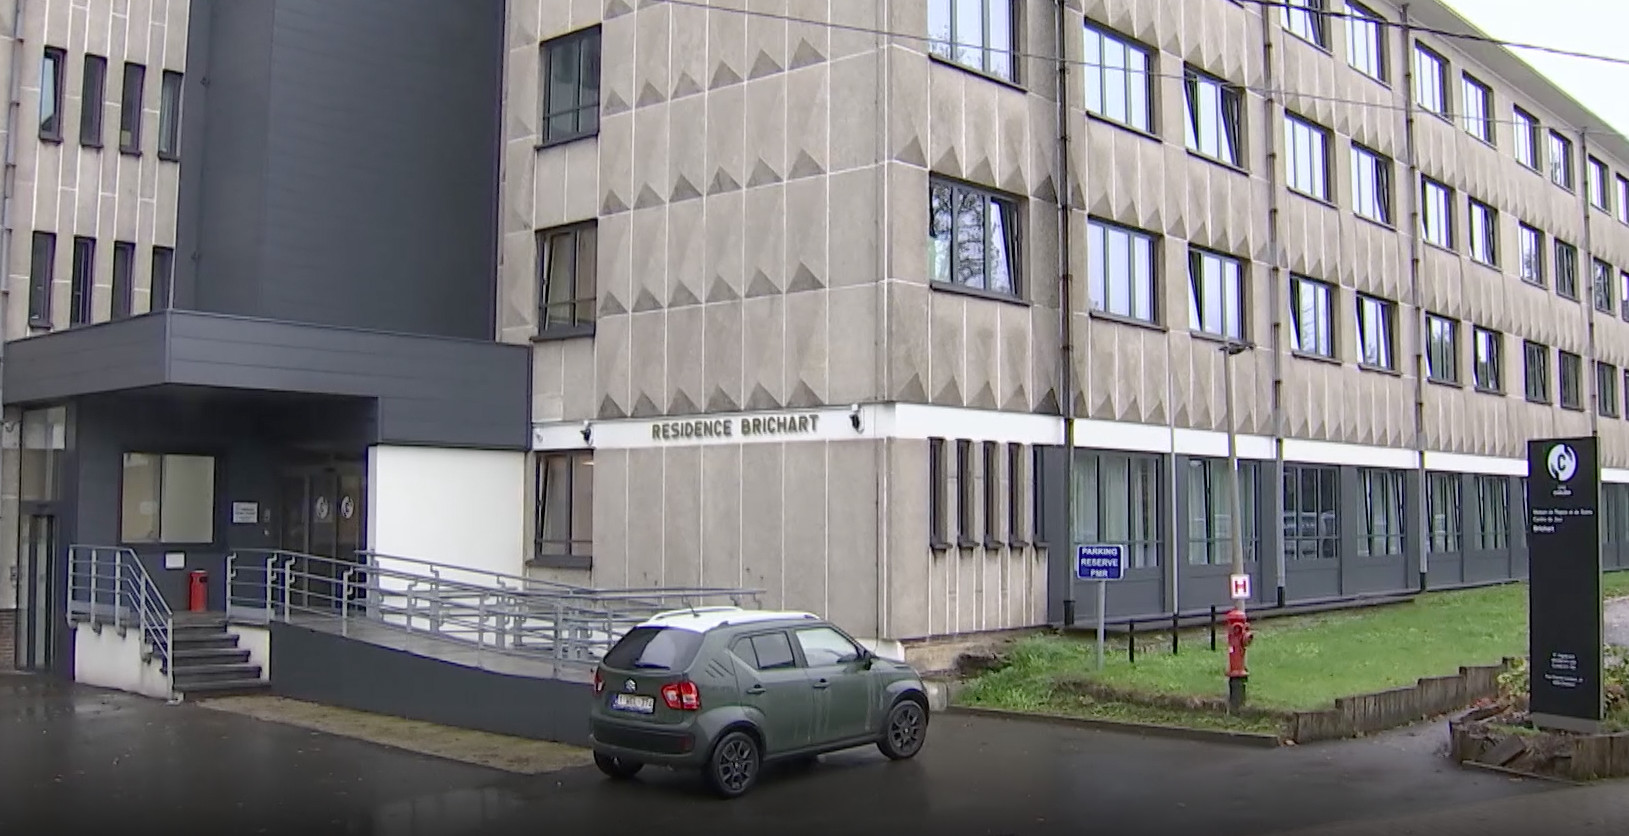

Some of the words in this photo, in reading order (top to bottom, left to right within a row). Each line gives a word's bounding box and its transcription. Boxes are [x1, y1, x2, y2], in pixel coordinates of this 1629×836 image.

[652, 419, 732, 440] RESIDENCE
[740, 414, 819, 436] BRICHART
[1081, 547, 1118, 556] PARKING
[1080, 558, 1119, 567] RESERVE
[1090, 569, 1108, 578] PMR
[1235, 580, 1246, 594] H
